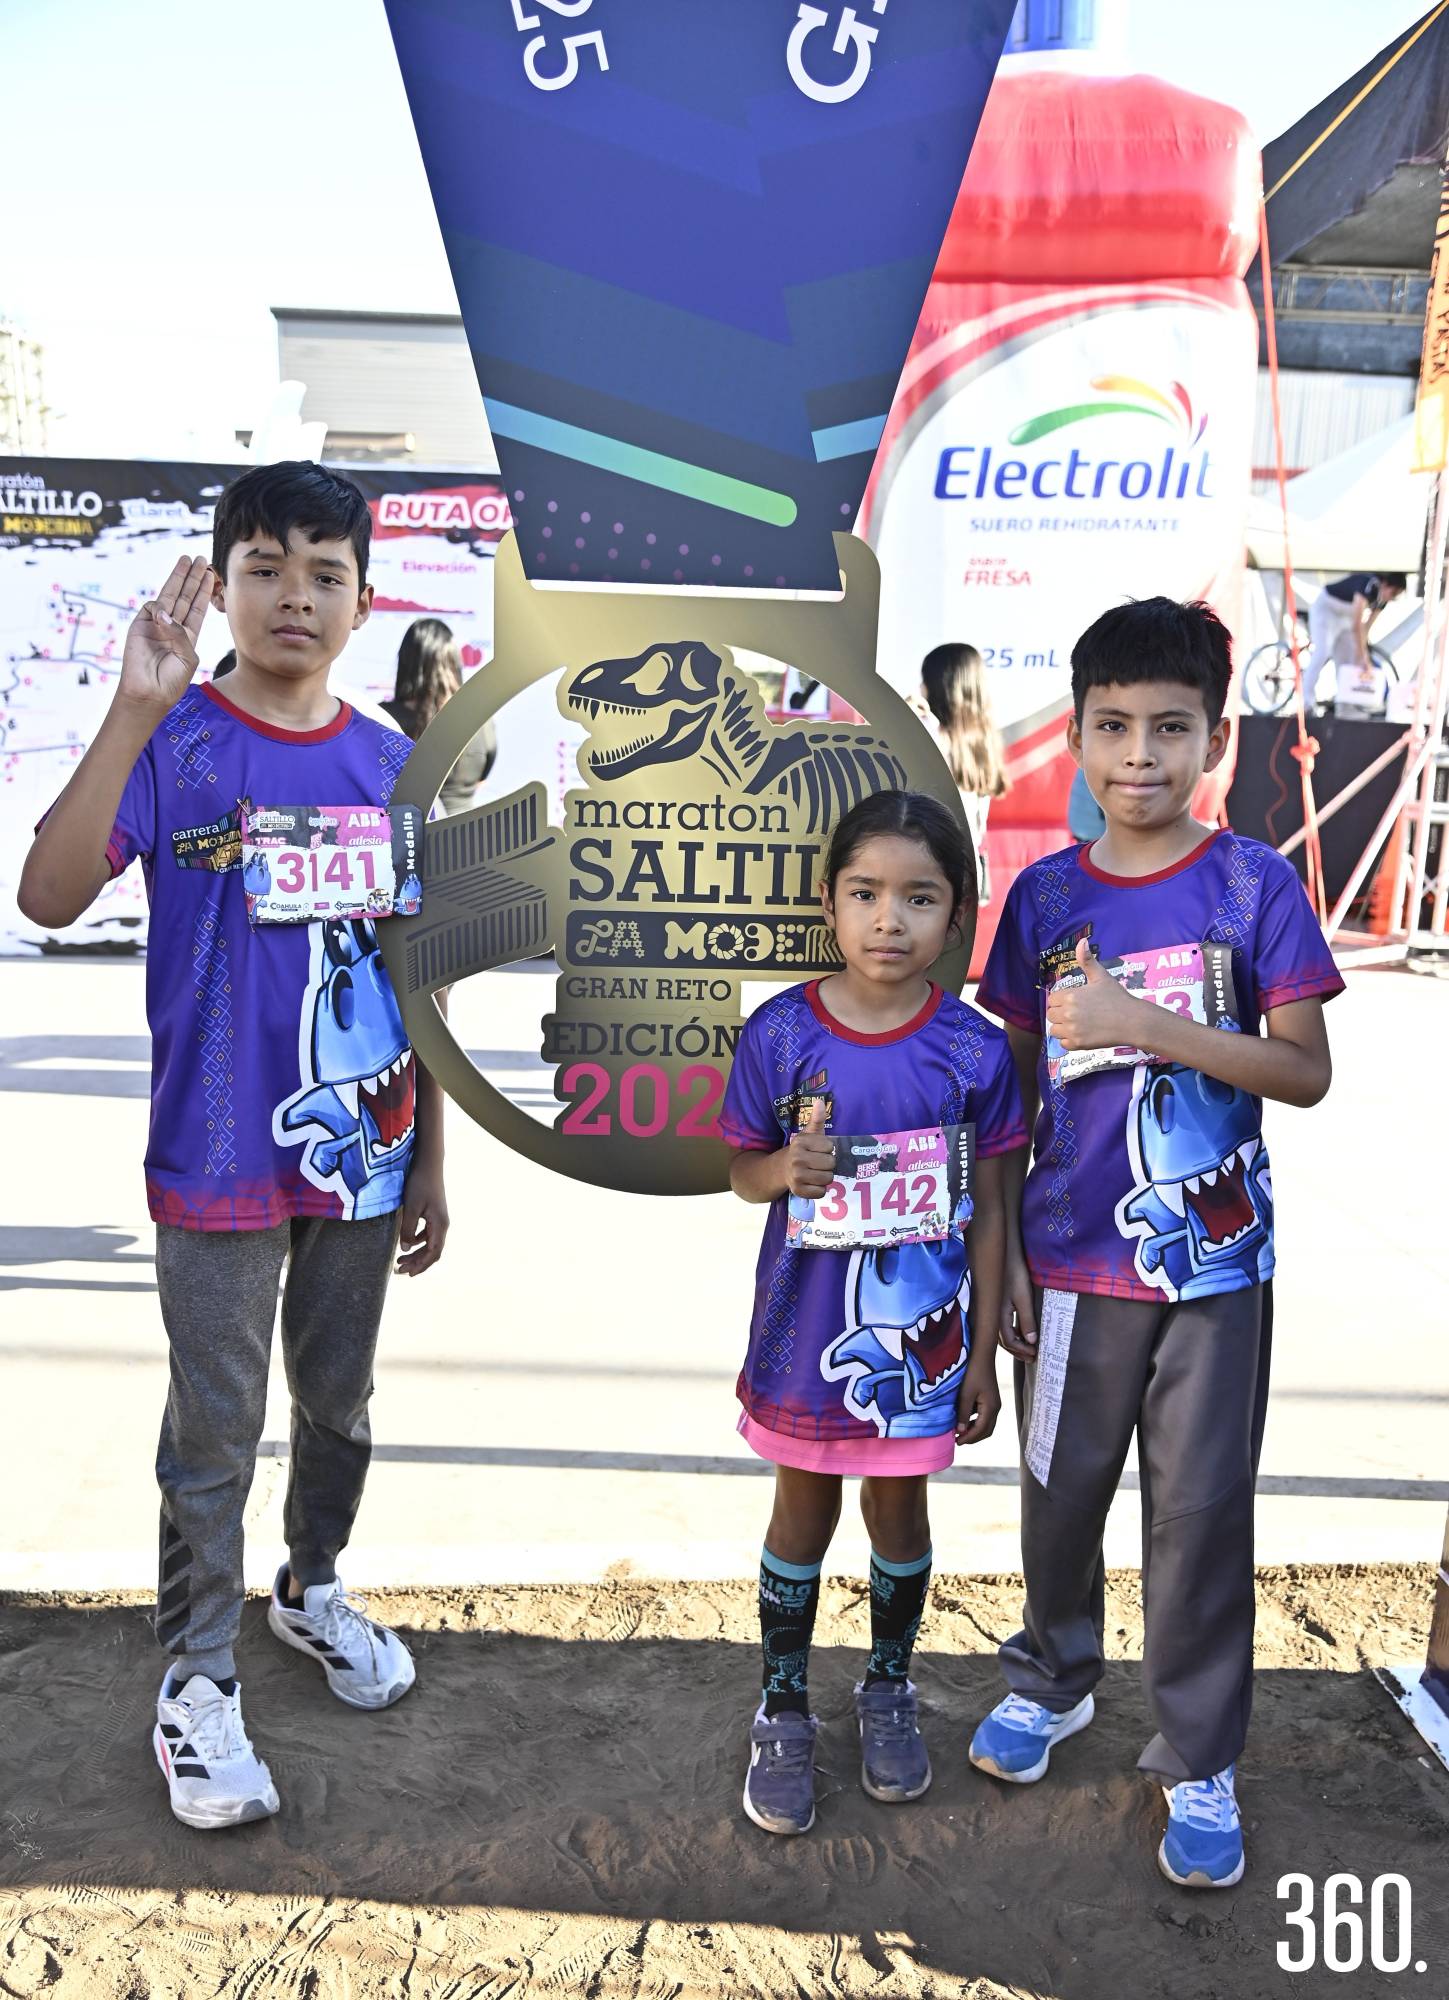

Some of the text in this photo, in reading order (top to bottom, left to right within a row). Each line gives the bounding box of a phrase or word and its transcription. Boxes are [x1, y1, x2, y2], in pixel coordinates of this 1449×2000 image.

[934, 447, 1214, 499] Electrolit
[385, 501, 465, 522] RUTA
[970, 518, 1179, 532] SUERO REHIDRATANTE
[403, 560, 476, 574] Elevación
[964, 570, 1031, 586] FRESA
[1024, 649, 1060, 667] mL
[348, 813, 381, 828] ABB
[574, 795, 790, 832] maraton
[172, 824, 219, 841] carrera
[255, 837, 287, 845] TRAC
[349, 835, 383, 846] atlesia
[403, 812, 415, 870] Medalla
[276, 851, 376, 893] 3141
[575, 919, 645, 958] LA
[1157, 952, 1192, 969] ABB
[566, 977, 731, 1001] GRAN RETO
[1158, 974, 1195, 987] atlesia
[1214, 950, 1226, 1011] Medalla
[550, 1017, 742, 1057] EDICIÓN
[852, 1146, 876, 1155] Cargo
[908, 1135, 938, 1152] ABB
[857, 1162, 880, 1172] BERRY
[907, 1158, 941, 1171] atlesia
[958, 1131, 968, 1190] Medalla
[820, 1174, 937, 1221] 3142
